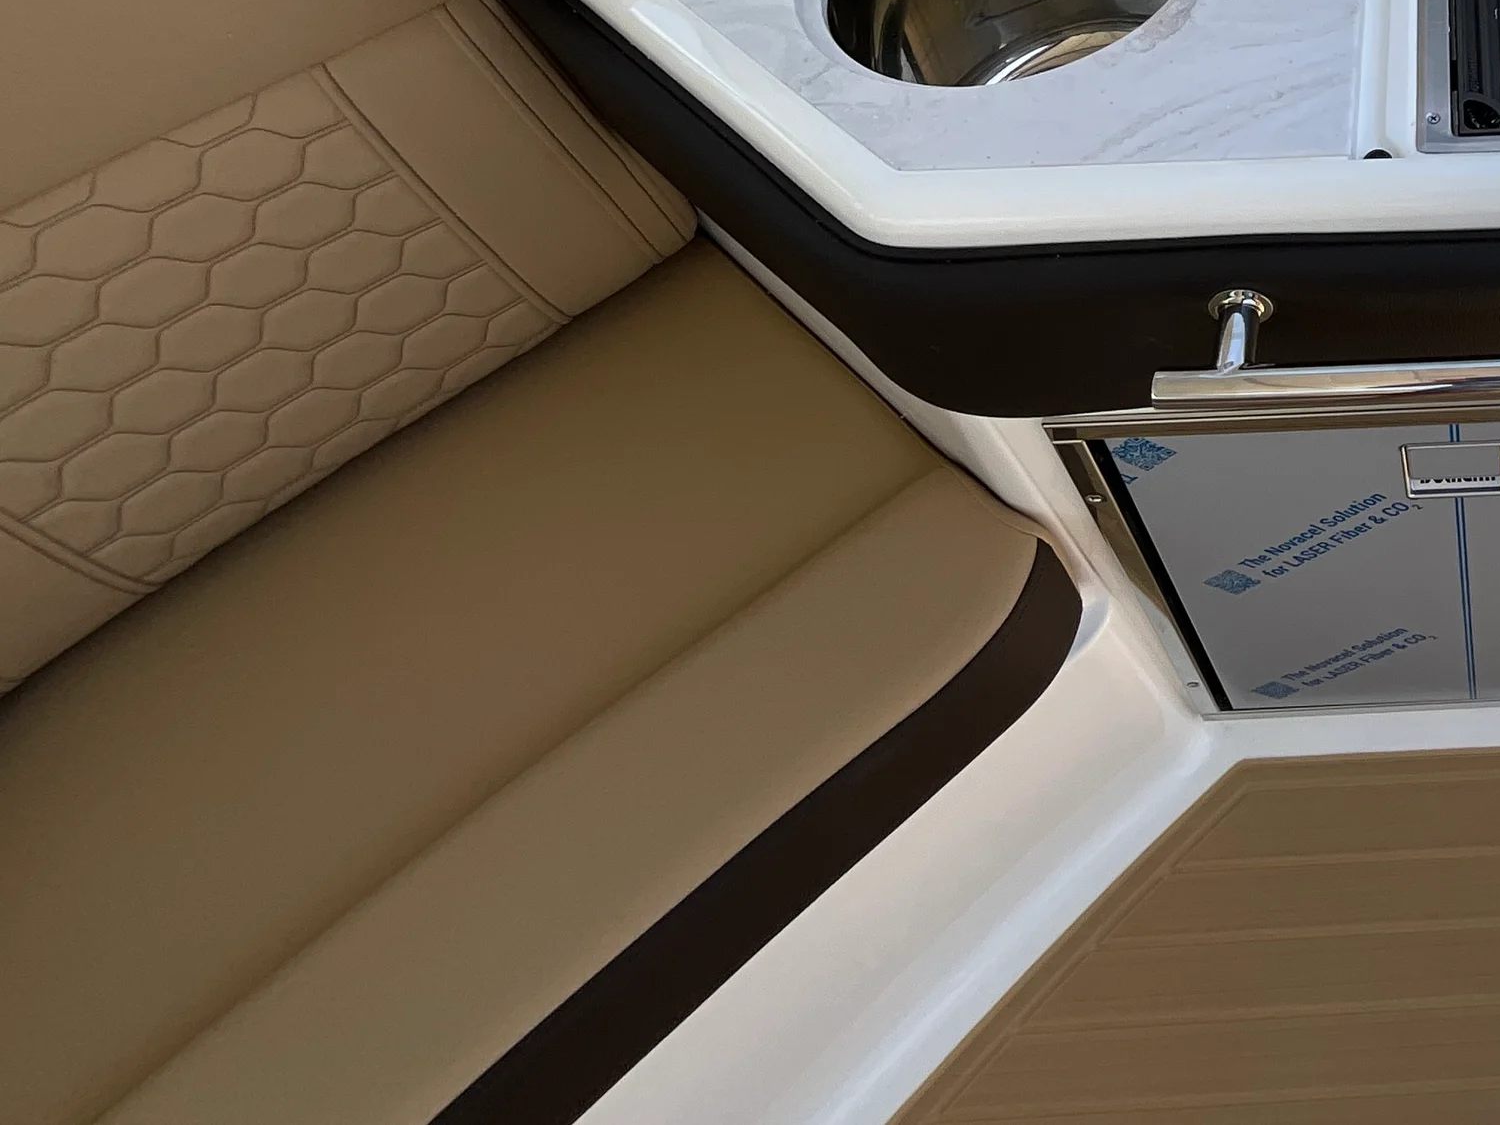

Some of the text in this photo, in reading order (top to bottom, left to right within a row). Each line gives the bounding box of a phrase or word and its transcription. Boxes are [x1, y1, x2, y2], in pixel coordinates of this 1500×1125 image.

[1238, 493, 1387, 569] The Novacel Solution
[1262, 565, 1289, 578] for
[1283, 541, 1337, 567] LASER
[1330, 523, 1373, 544] Fiber
[1368, 515, 1388, 525] &
[1281, 628, 1409, 681] The Novacel Solution
[1302, 678, 1324, 687] for
[1359, 648, 1395, 663] Fiber
